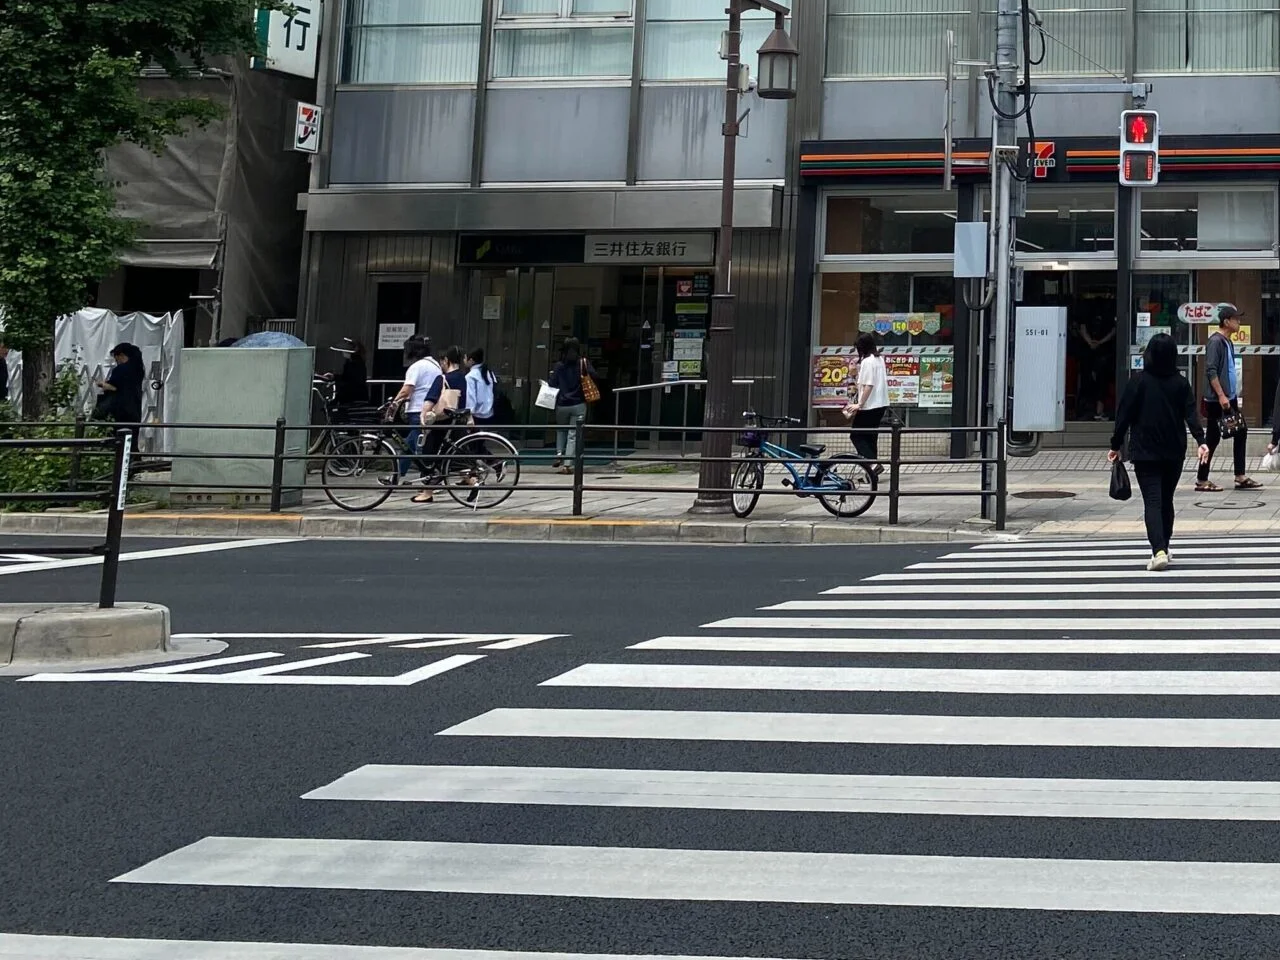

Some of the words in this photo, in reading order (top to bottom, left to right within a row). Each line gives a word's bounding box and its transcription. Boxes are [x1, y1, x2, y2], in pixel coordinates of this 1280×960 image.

[1027, 159, 1056, 167] EVEN
[594, 241, 687, 258] 三井住友銀行
[1184, 305, 1213, 319] たばこ
